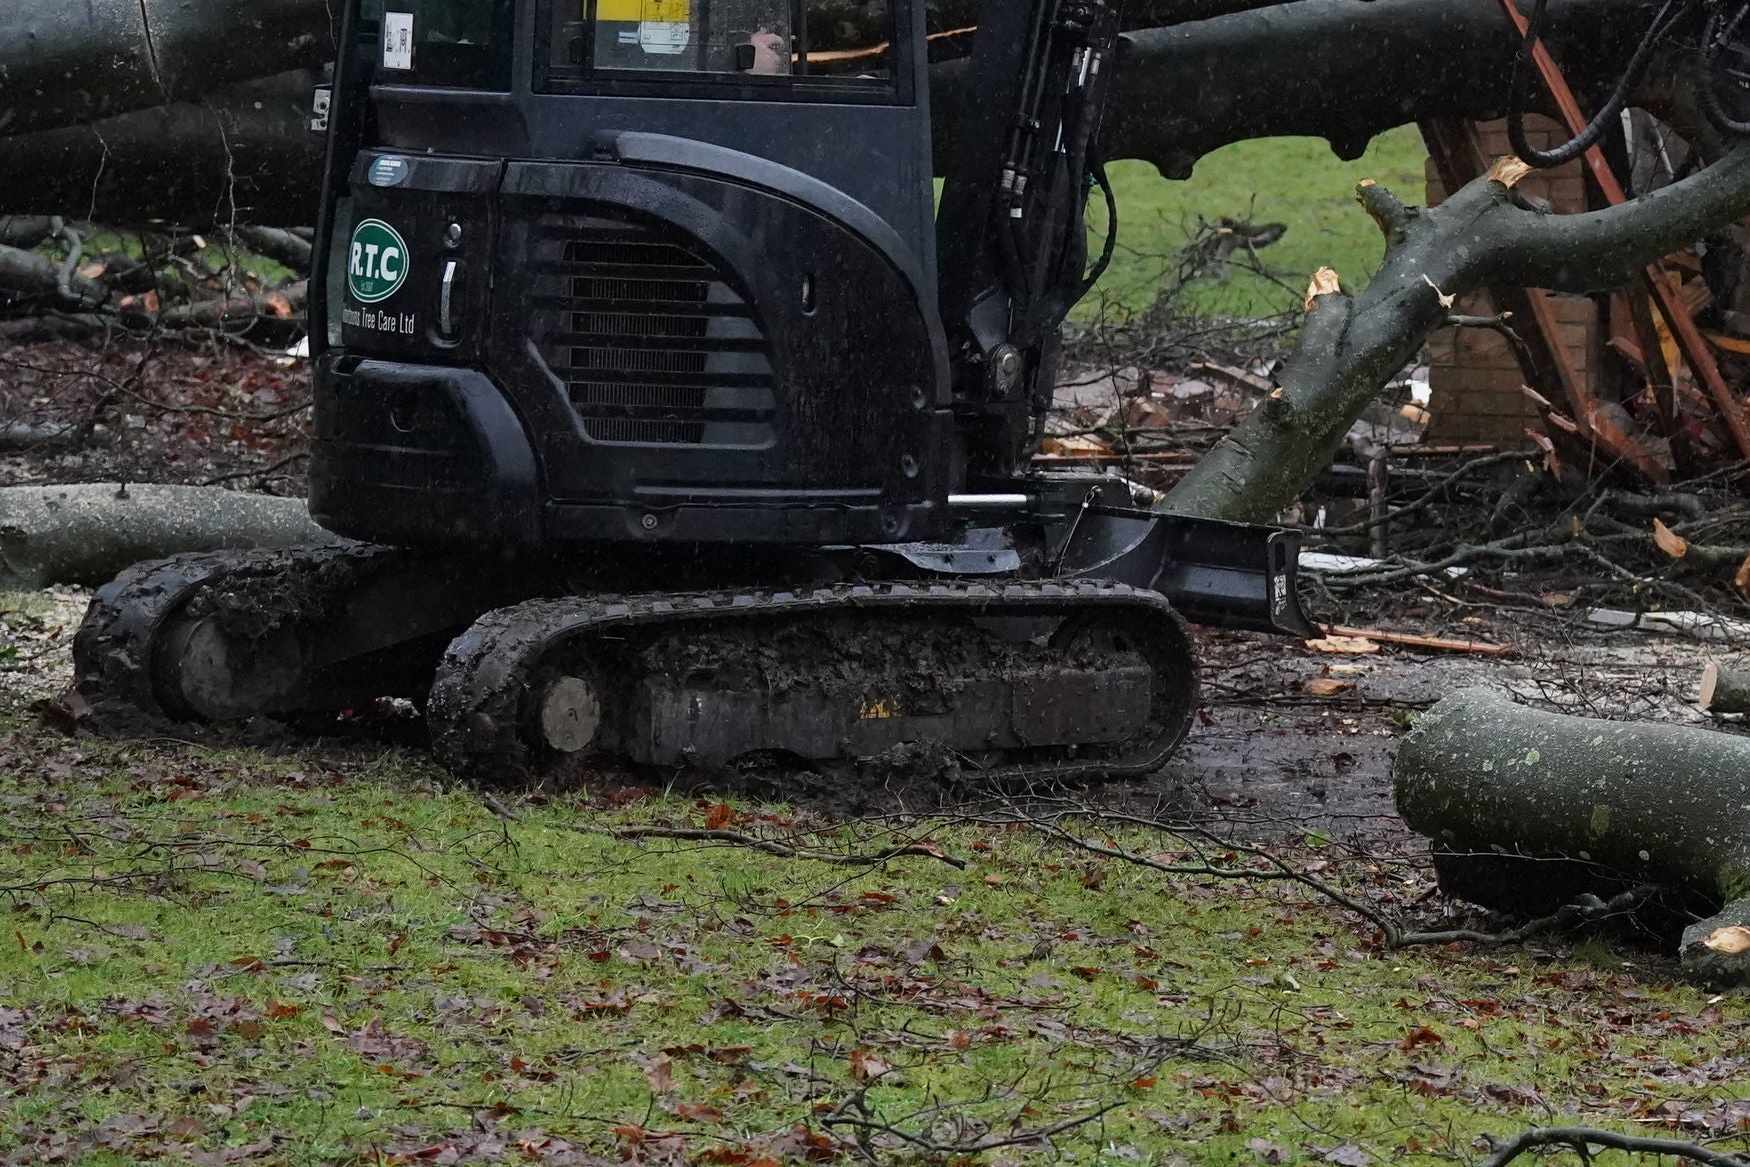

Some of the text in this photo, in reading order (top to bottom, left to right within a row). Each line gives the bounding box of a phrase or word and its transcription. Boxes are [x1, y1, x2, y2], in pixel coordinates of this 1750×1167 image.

[350, 241, 399, 282] R.T.C
[362, 307, 376, 329] Tree
[378, 310, 396, 332] Care
[400, 312, 415, 334] Ltd
